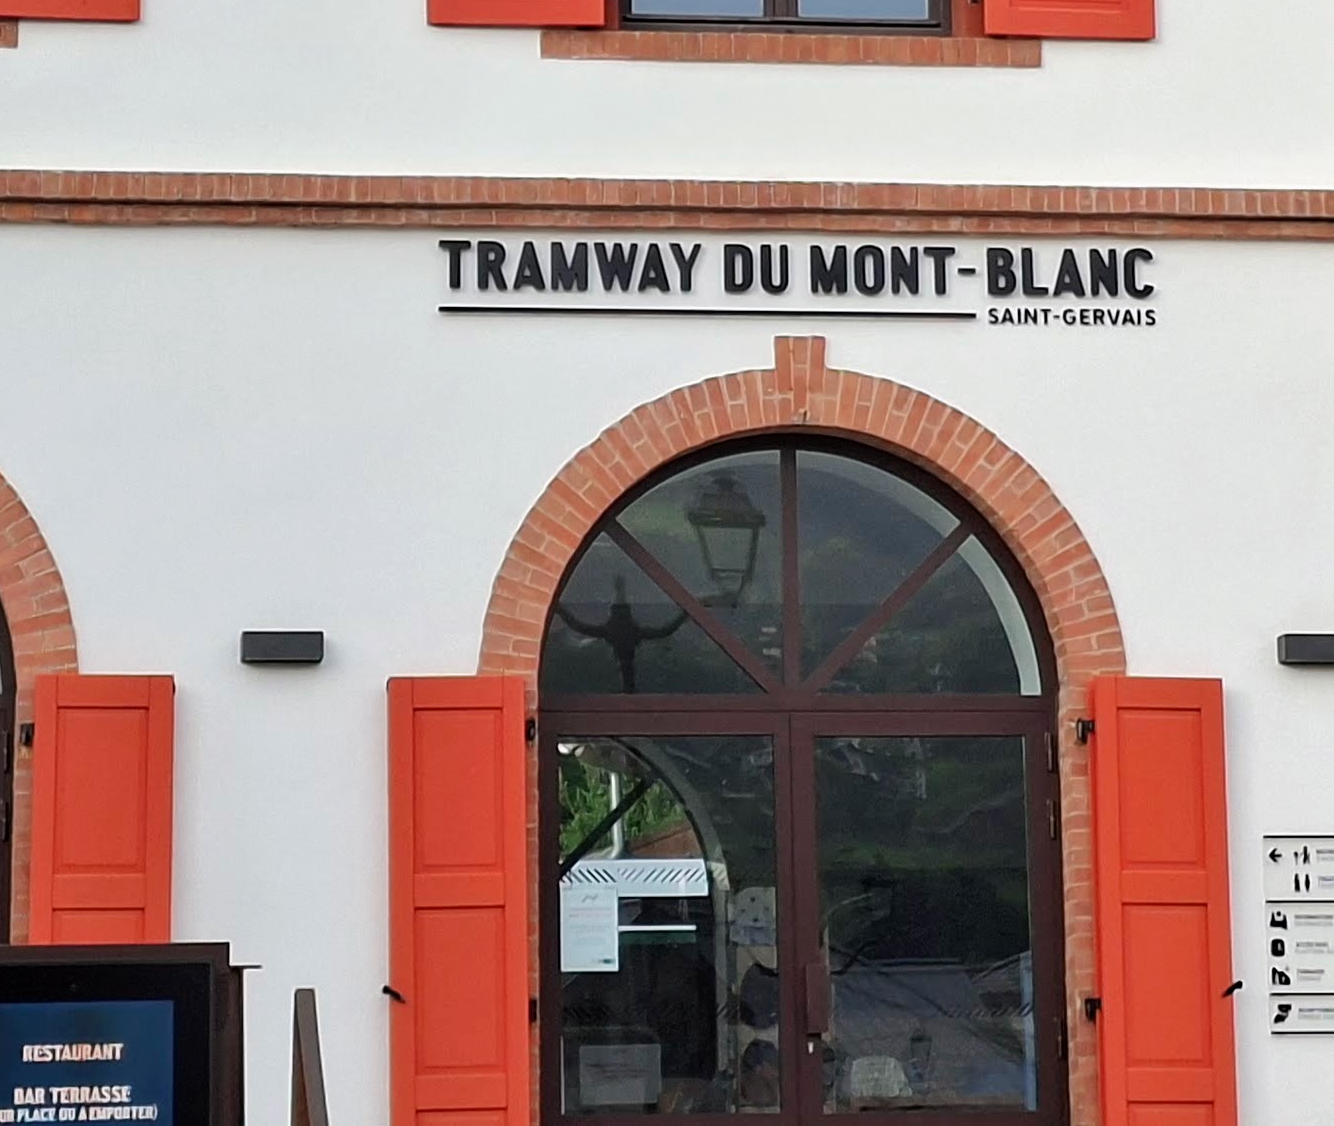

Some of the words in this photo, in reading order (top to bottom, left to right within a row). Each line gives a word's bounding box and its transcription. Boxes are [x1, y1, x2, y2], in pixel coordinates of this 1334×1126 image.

[438, 240, 702, 292] TRAMWAY
[723, 243, 789, 294] DU
[809, 244, 1155, 299] MONT-BLANC
[987, 307, 1157, 326] SAINT-GERVAIS
[22, 1043, 124, 1062] RESTAURANT
[14, 1087, 45, 1105] BAR
[49, 1085, 132, 1104] TERRASSE
[17, 1107, 56, 1122] PLACE
[58, 1107, 76, 1121] OU
